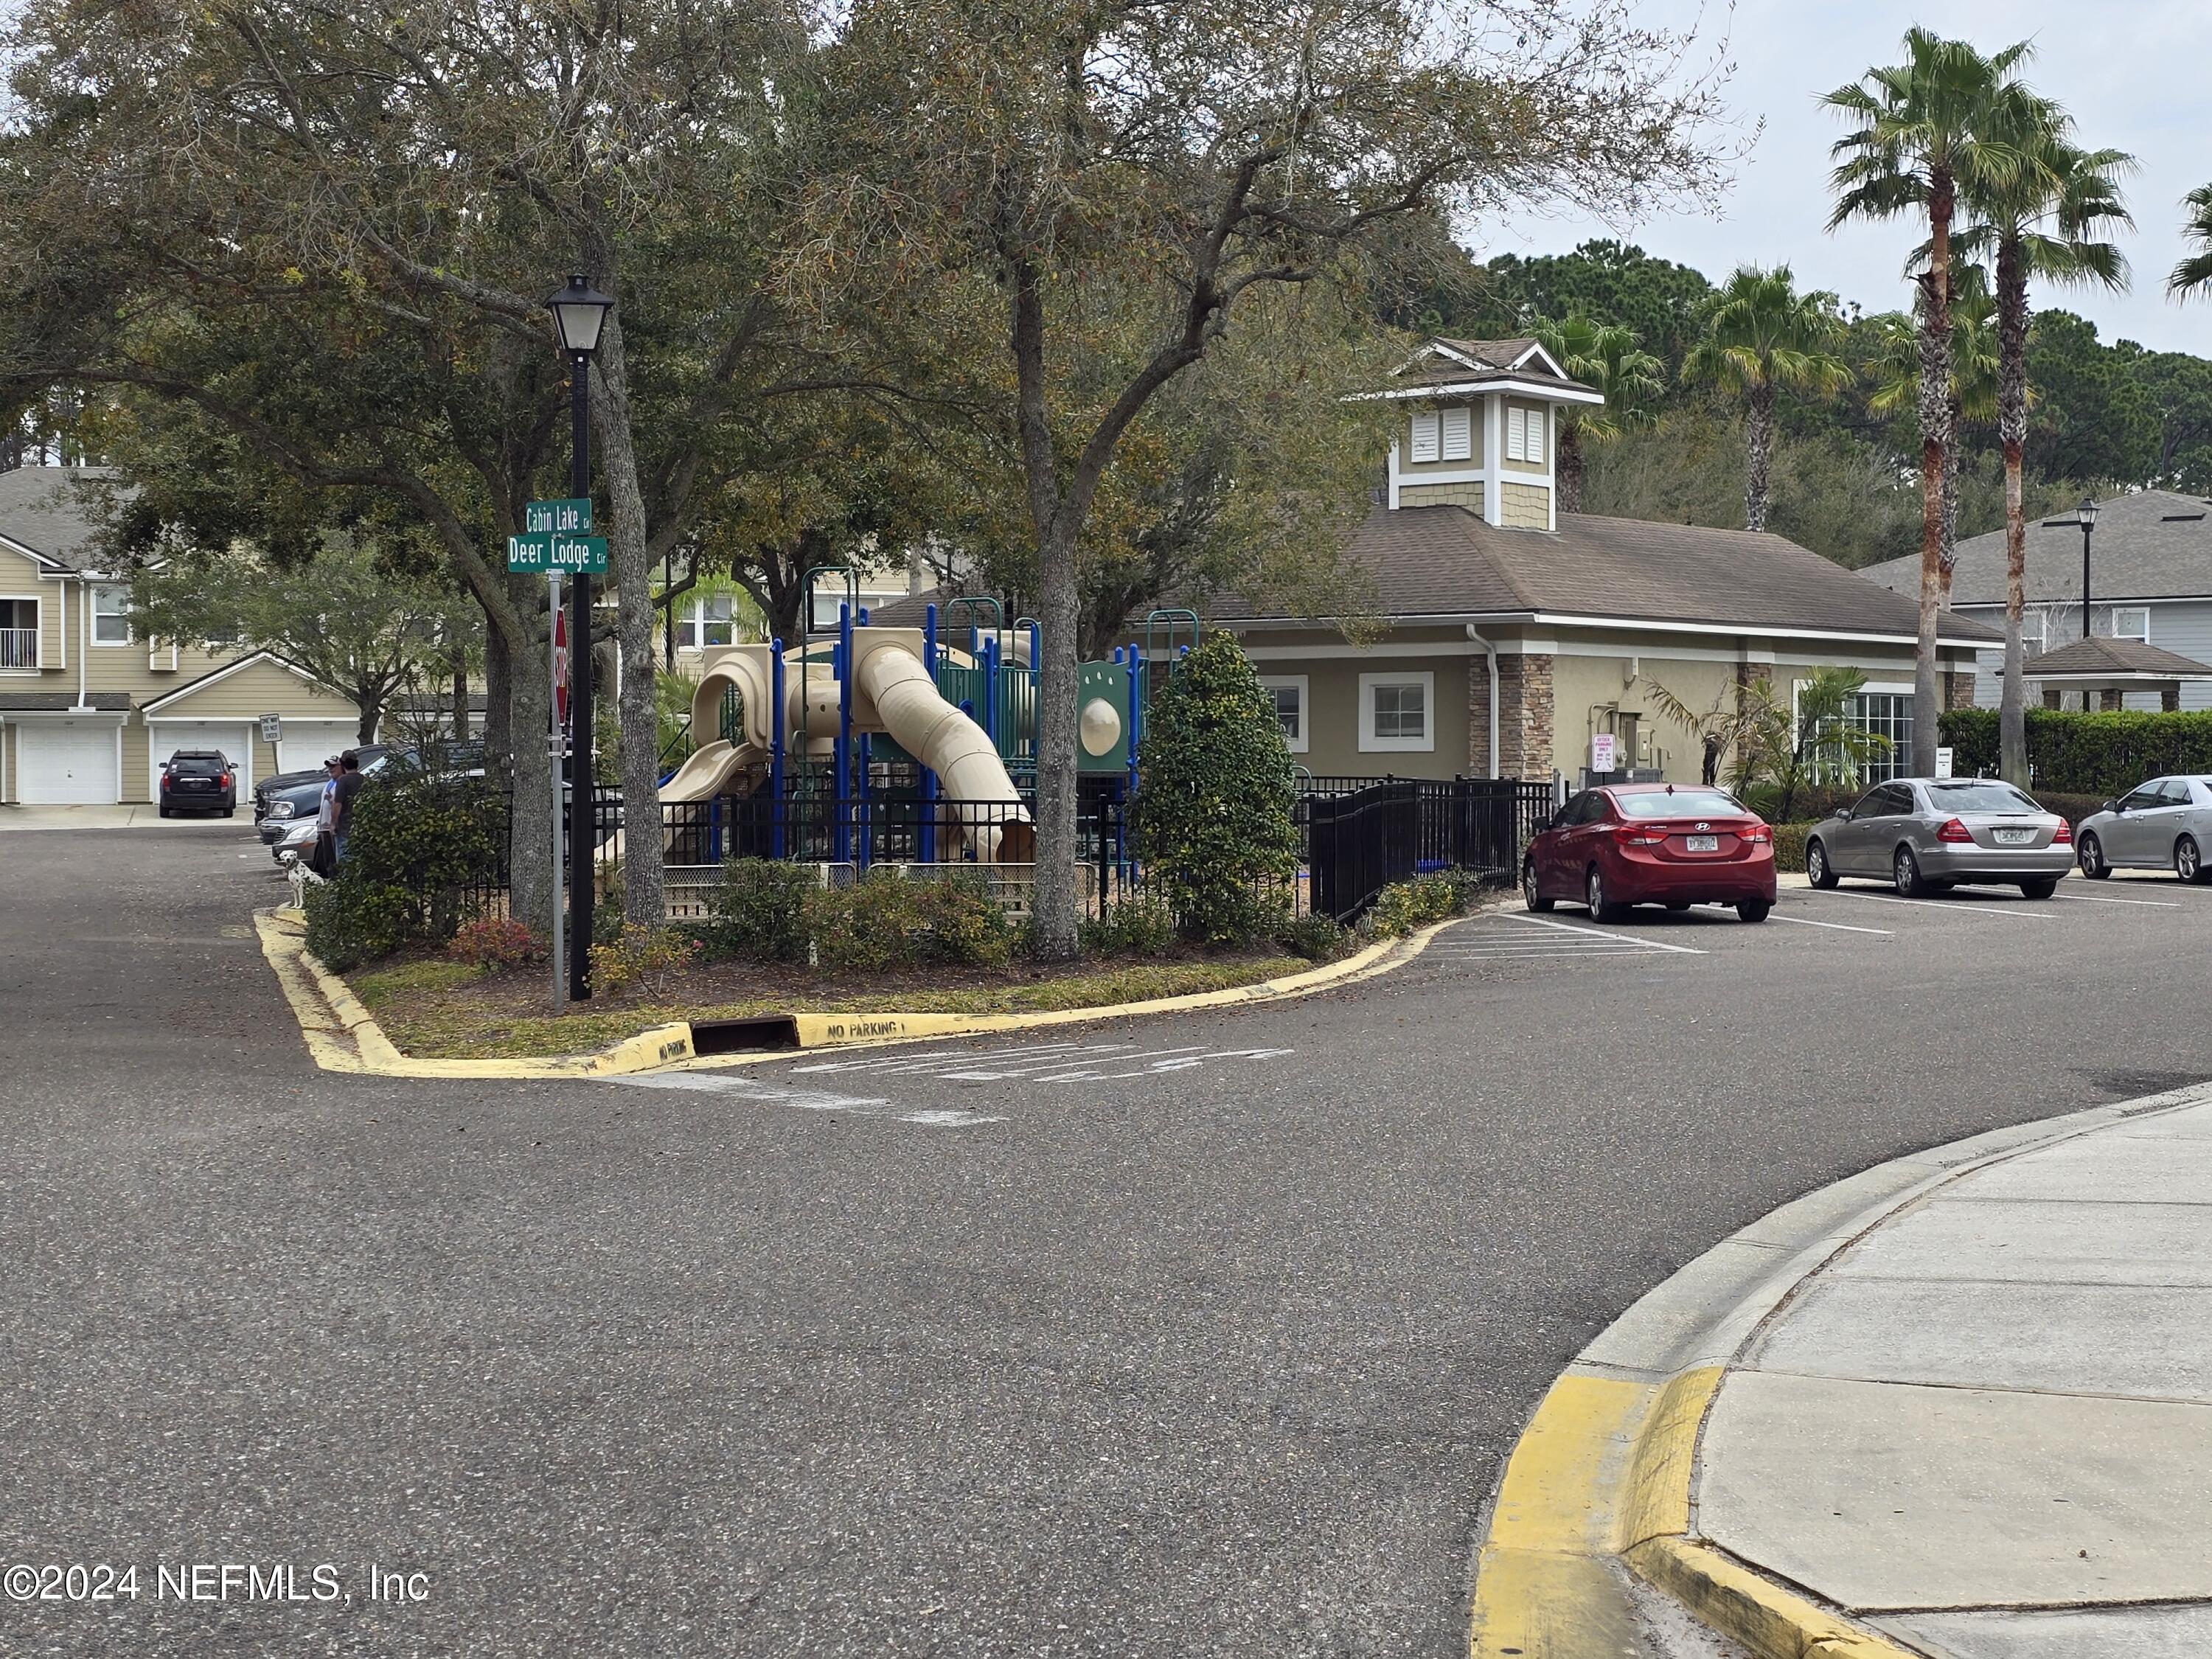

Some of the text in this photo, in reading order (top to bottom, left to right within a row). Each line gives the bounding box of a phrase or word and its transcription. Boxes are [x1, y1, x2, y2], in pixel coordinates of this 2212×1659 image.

[526, 507, 552, 532] Cabin
[557, 505, 578, 531] Lake
[509, 537, 606, 572] Deer Lodge Cir
[555, 646, 566, 687] STOP
[827, 1021, 897, 1038] NO PARKING
